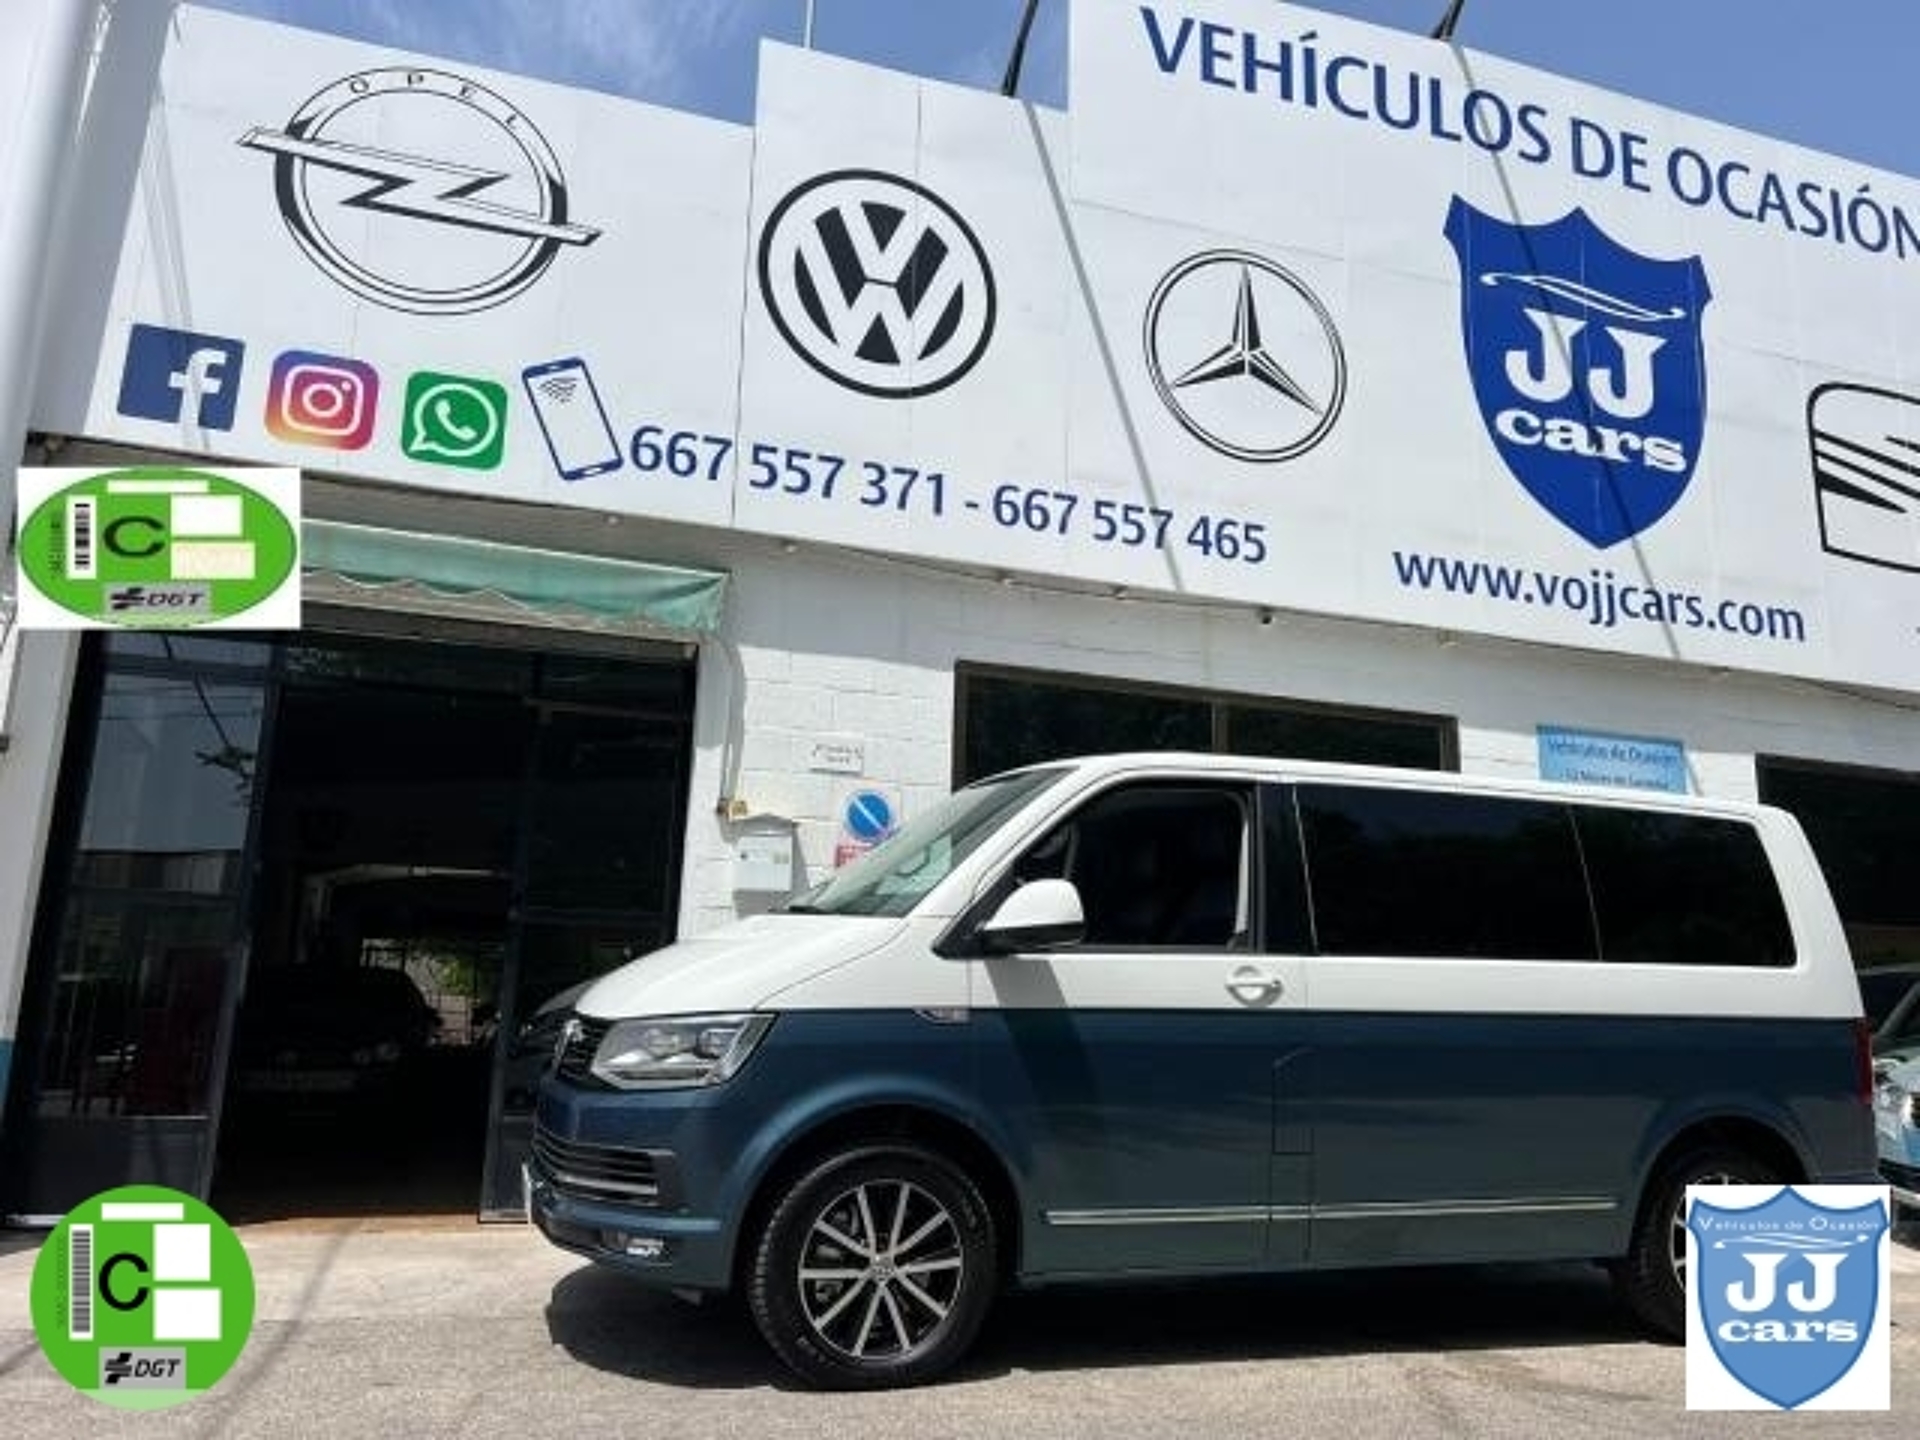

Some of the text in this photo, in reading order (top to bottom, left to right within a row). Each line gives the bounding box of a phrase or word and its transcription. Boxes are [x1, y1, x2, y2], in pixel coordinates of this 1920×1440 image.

[1139, 6, 1552, 164] VEHÍCULOS
[1570, 117, 1651, 193] DE
[1505, 308, 1668, 419] JJ
[628, 425, 734, 481] 667
[748, 443, 847, 498] 557
[859, 460, 945, 517] 371
[992, 484, 1079, 536] 667
[1092, 500, 1174, 550] 557
[1186, 514, 1269, 565] 465
[1496, 409, 1687, 473] cars
[1394, 550, 1806, 643] www.vojjcars.com
